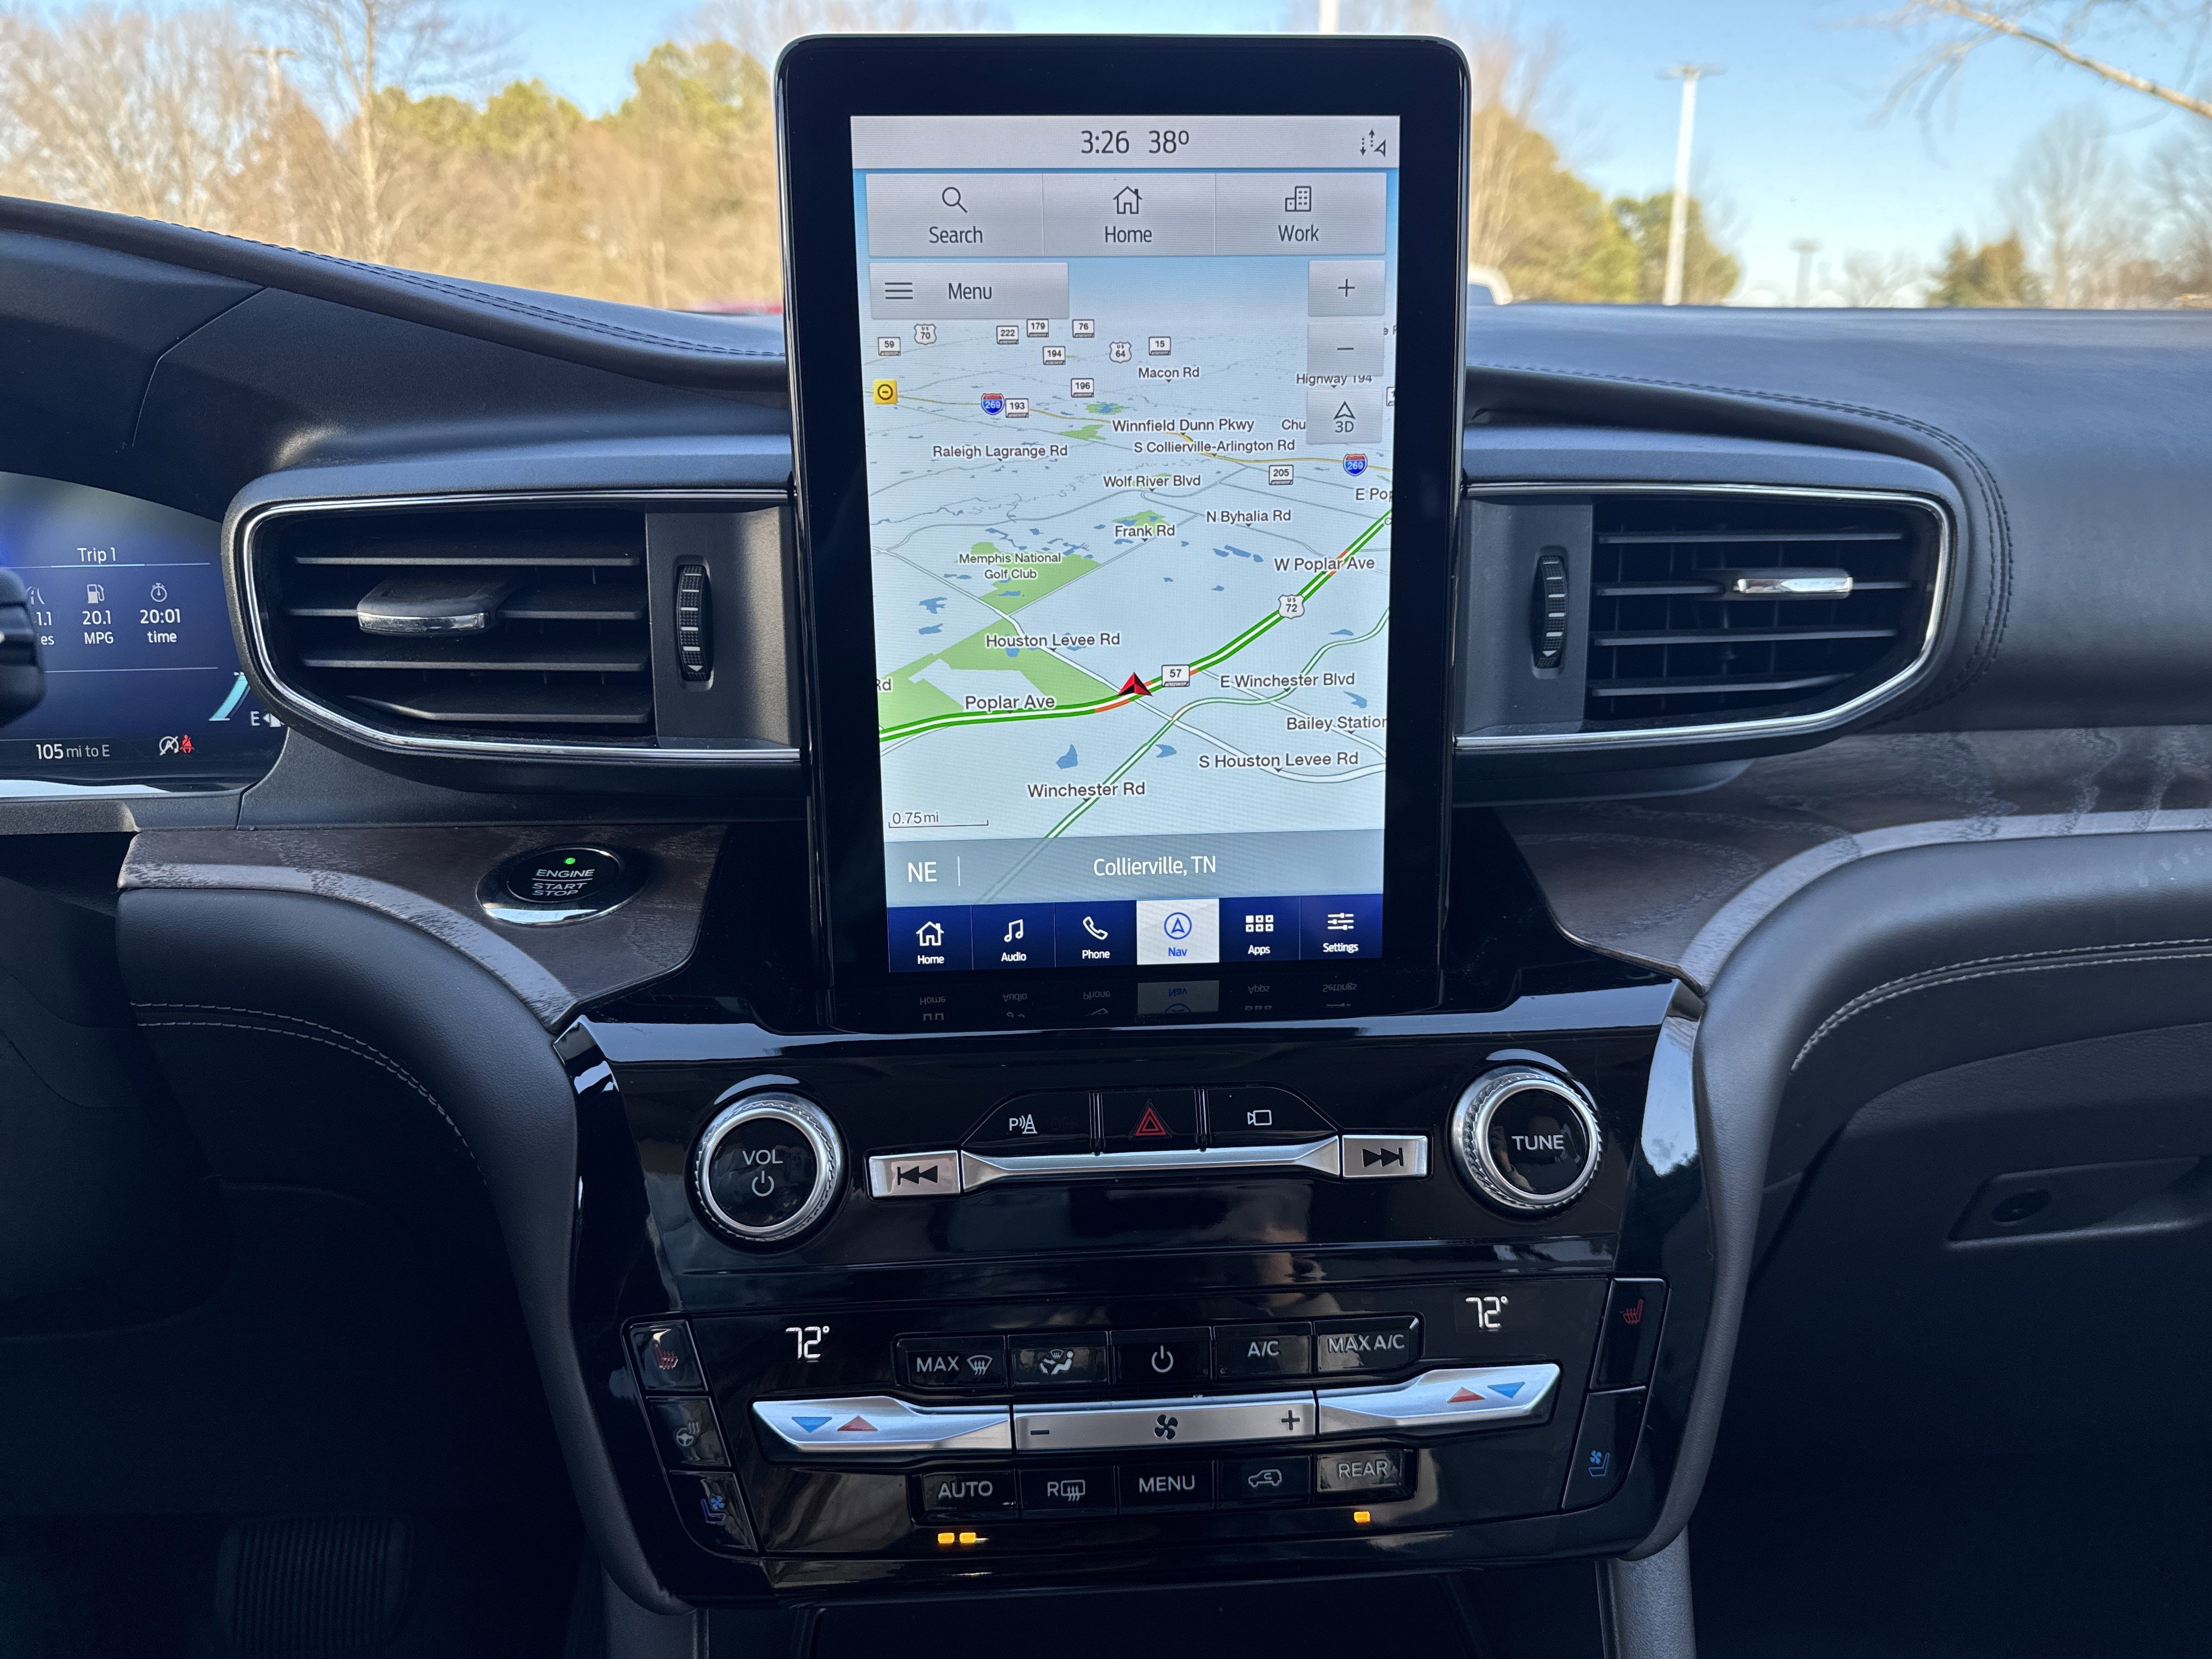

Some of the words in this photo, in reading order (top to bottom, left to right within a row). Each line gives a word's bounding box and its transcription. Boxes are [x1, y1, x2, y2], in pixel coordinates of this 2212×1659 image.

[1080, 130, 1130, 154] 3:26
[929, 226, 984, 244] Search
[1104, 225, 1153, 244] Home
[1278, 224, 1319, 242] Work
[947, 283, 992, 301] Menu
[1031, 322, 1045, 330] 179
[884, 340, 895, 348] 59
[1047, 349, 1062, 358] 194
[1138, 368, 1180, 379] Macon
[1182, 366, 1200, 377] Rd
[1075, 382, 1091, 390] 196
[985, 400, 1001, 409] 269
[1009, 402, 1025, 410] 193
[1113, 419, 1175, 432] Winnfield
[1179, 419, 1215, 431] Dunn
[1219, 419, 1255, 433] Pkwy
[1334, 421, 1354, 433] 3D
[933, 445, 981, 459] Raleigh
[986, 445, 1046, 459] Lagrange
[1050, 445, 1068, 456] Rd
[1134, 442, 1143, 453] S
[1146, 440, 1273, 454] Collierville-Arlington
[1278, 439, 1295, 451] Rd
[1273, 469, 1289, 477] 205
[1347, 461, 1364, 470] 269
[1103, 476, 1132, 488] Wolf
[1135, 476, 1170, 487] River
[1173, 475, 1201, 486] Blvd
[1356, 488, 1365, 500] E
[1206, 511, 1218, 523] N
[1221, 511, 1269, 526] Byhalia
[1273, 510, 1291, 522] Rd
[1115, 526, 1152, 537] Frank
[1156, 524, 1176, 537] Rd
[77, 547, 109, 564] Trip
[111, 547, 116, 562] 1
[959, 553, 1011, 565] Memphis
[1015, 552, 1061, 563] National
[1274, 558, 1290, 571] W
[1294, 557, 1344, 573] Poplar
[1347, 557, 1375, 569] Ave
[984, 569, 1008, 579] Golf
[1011, 568, 1037, 579] Club
[1286, 603, 1297, 613] 72
[33, 611, 52, 626] 1.1
[82, 610, 111, 625] 20.1
[140, 608, 181, 624] 20:01
[84, 631, 114, 645] MPG
[147, 630, 177, 644] time
[986, 635, 1047, 648] Houston
[1052, 634, 1095, 647] Levee
[1100, 633, 1120, 646] Rd
[1169, 669, 1182, 678] 57
[1221, 676, 1231, 687] E
[1234, 674, 1319, 688] Winchester
[1323, 673, 1355, 686] Blvd
[965, 695, 1020, 712] Poplar
[1024, 695, 1055, 708] Ave
[251, 711, 260, 726] E
[1286, 716, 1333, 732] Bailey
[36, 743, 64, 760] 105
[66, 744, 82, 758] mi
[85, 746, 99, 758] to
[102, 744, 110, 757] E
[1199, 755, 1211, 769] S
[1215, 753, 1280, 769] Houston
[1285, 753, 1331, 766] Levee
[1337, 752, 1358, 765] Rd
[1027, 782, 1118, 799] Winchester
[1123, 782, 1146, 796] Rd
[535, 869, 595, 878] ENGINE
[907, 862, 937, 883] NE
[1093, 857, 1187, 877] Collierville,
[1190, 856, 1216, 874] TN
[1081, 948, 1110, 960] Phone
[1167, 946, 1188, 957] Nav
[1248, 944, 1271, 957] Apps
[1322, 941, 1359, 955] Settings
[917, 953, 944, 964] Home
[1001, 950, 1027, 962] Audio
[1511, 1134, 1565, 1151] TUNE
[742, 1149, 783, 1166] VOL
[1247, 1341, 1279, 1358] A/C
[1328, 1336, 1370, 1354] MAX
[1374, 1334, 1405, 1351] A/C
[916, 1356, 960, 1374] MAX
[1338, 1459, 1389, 1478] REAR
[938, 1481, 994, 1499] AUTO
[1047, 1482, 1059, 1497] R
[1138, 1475, 1195, 1494] MENU
